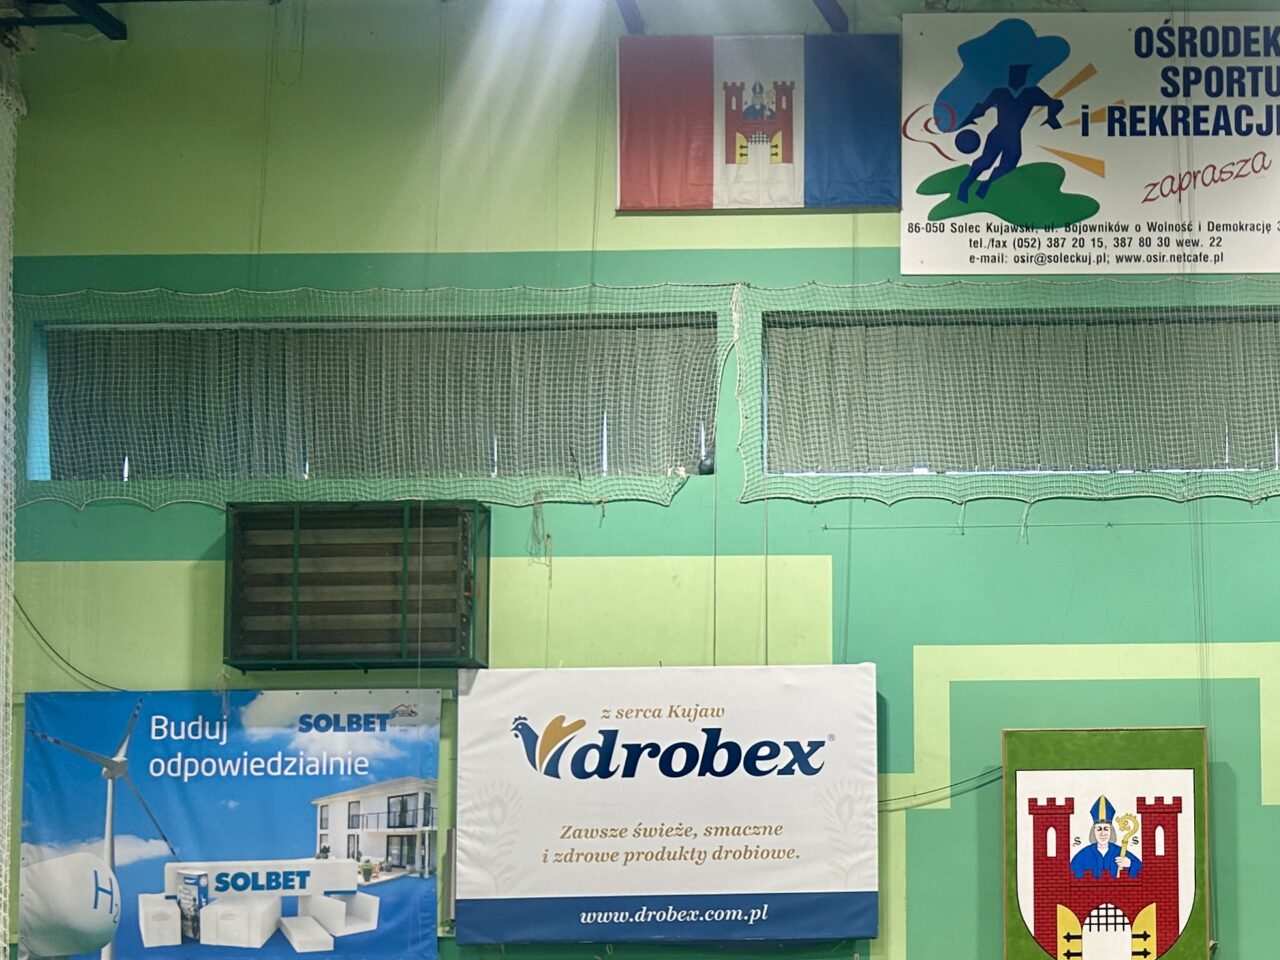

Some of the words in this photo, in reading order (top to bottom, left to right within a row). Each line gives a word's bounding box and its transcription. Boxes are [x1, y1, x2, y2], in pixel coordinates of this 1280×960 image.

[1081, 104, 1089, 137] i
[1141, 150, 1272, 204] zaprasza
[907, 222, 945, 234] 86-050
[950, 222, 981, 234] Solec
[986, 222, 1038, 235] Kujawski,
[1044, 221, 1058, 233] ul.
[1064, 220, 1130, 235] Bojowników
[1134, 223, 1141, 233] o
[1146, 220, 1193, 233] Wolność
[1207, 220, 1272, 234] Demokrację
[969, 237, 1007, 249] tel./fax
[1012, 237, 1041, 250] (052)
[1046, 237, 1066, 248] 387
[1071, 237, 1085, 248] 20
[1091, 237, 1108, 250] 15,
[1113, 237, 1133, 248] 387
[1138, 237, 1152, 248] 80
[1157, 236, 1171, 247] 30
[1175, 238, 1204, 248] wew.
[1209, 236, 1223, 247] 22
[969, 252, 1008, 264] e-mail:
[1013, 252, 1110, 266] osir@soleckuj.pl;
[1115, 251, 1224, 265] www.osir.netcafe.pl
[298, 713, 391, 733] SOLBET
[600, 708, 610, 720] z
[615, 706, 662, 720] serca
[668, 704, 725, 723] Kujaw
[150, 714, 228, 746] Buduj
[570, 727, 826, 780] drobex
[149, 751, 370, 783] odpowiedzialnie
[560, 825, 628, 840] Zawsze
[632, 822, 698, 840] świeże,
[703, 823, 783, 837] smaczne
[542, 849, 549, 863] i
[553, 848, 620, 863] zdrowe
[623, 846, 708, 866] produkty
[712, 845, 800, 861] drobiowe.
[214, 870, 311, 893] SOLBET
[580, 904, 768, 925] www.drobex.com.pl
